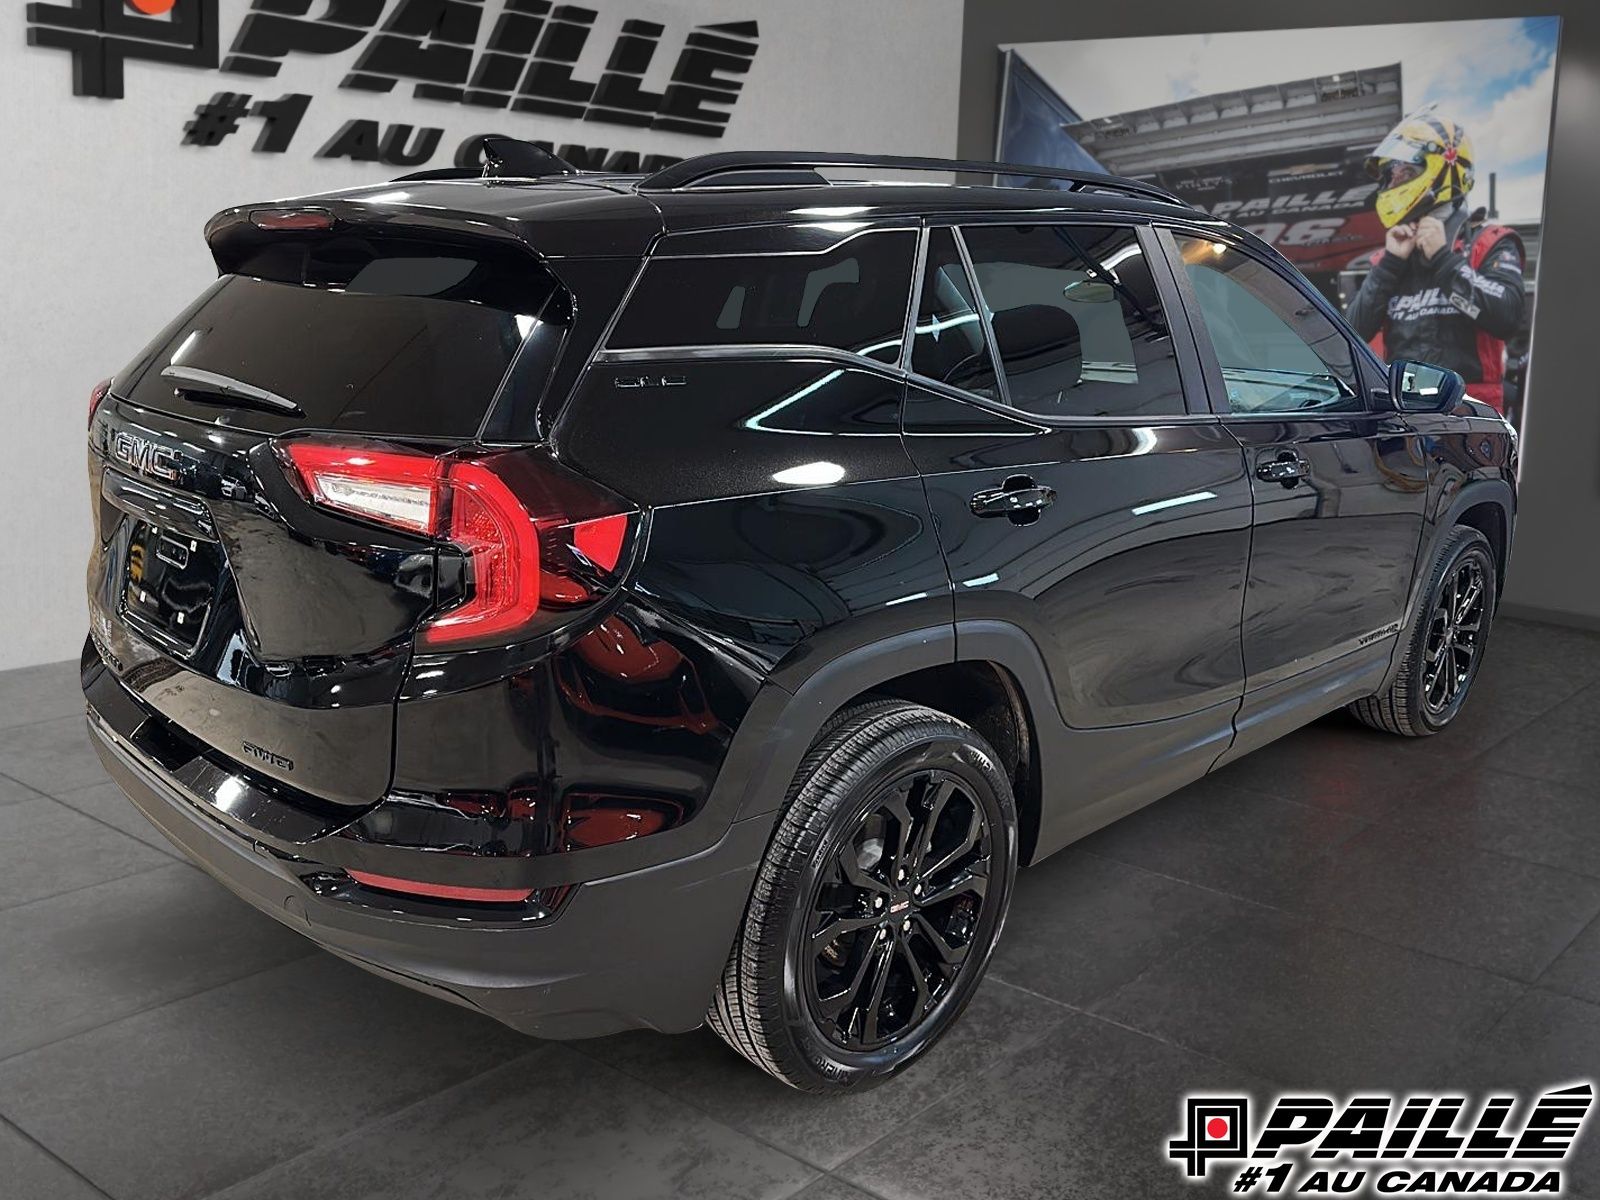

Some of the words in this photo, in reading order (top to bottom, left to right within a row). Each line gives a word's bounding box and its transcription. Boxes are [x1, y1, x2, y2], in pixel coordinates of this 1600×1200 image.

[220, 0, 760, 138] PAILLÉ
[180, 92, 313, 154] #1
[313, 119, 445, 167] AU
[1268, 170, 1344, 184] CHEVROLET
[115, 430, 182, 482] GMC
